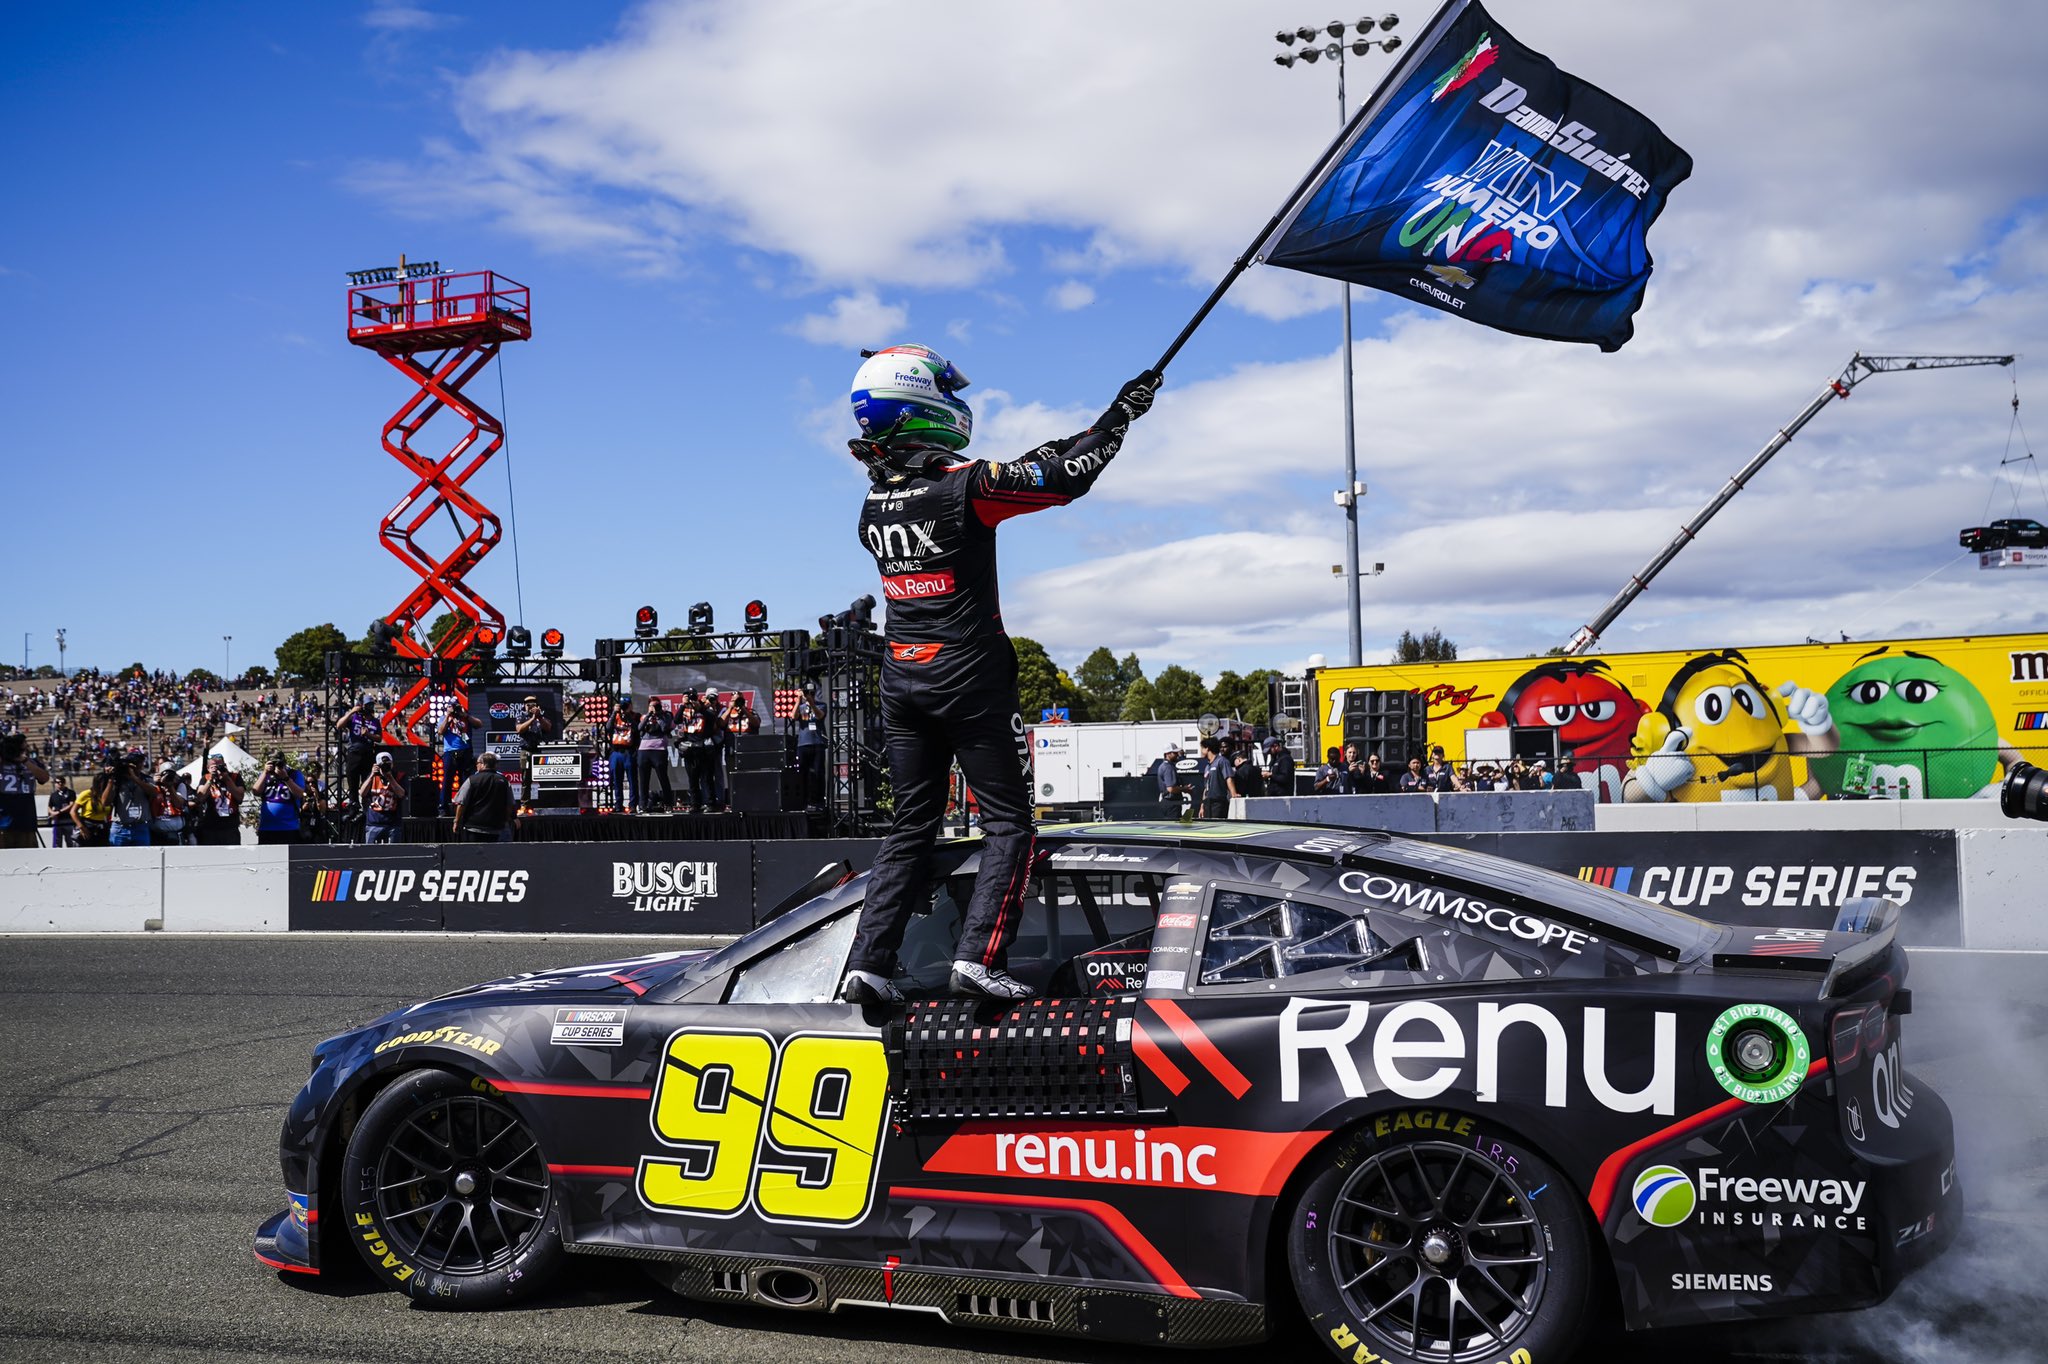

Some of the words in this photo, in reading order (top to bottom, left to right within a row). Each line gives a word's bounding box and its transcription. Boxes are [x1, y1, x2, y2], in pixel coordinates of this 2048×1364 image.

[1549, 121, 1650, 201] Suárez
[1461, 139, 1582, 222] WIN
[1409, 277, 1466, 310] CHEVROLET
[895, 372, 932, 387] Freeway
[895, 382, 932, 391] INSURANCE
[867, 520, 943, 558] onx
[885, 560, 923, 574] HOMES
[905, 578, 946, 599] Renu
[1010, 712, 1034, 776] onx
[547, 756, 574, 764] NASCAR
[354, 870, 416, 901] CUP
[419, 870, 529, 902] SERIES
[612, 861, 718, 897] BUSCH
[1639, 866, 1734, 906] CUP
[1742, 866, 1918, 907] SERIES
[1152, 946, 1190, 954] COMMSCOPE
[1087, 962, 1125, 976] onx
[561, 1026, 581, 1037] CUP
[581, 1027, 614, 1038] SERIES
[577, 1011, 616, 1022] NASCAR
[1712, 1016, 1730, 1036] GET
[1729, 1005, 1800, 1041] BIOETHANOL
[374, 1026, 501, 1056] GOODYEAR
[1279, 997, 1676, 1116] Renu
[1714, 1065, 1734, 1087] GET
[636, 1026, 891, 1229] 99
[1374, 1109, 1476, 1138] EAGLE
[995, 1129, 1217, 1186] renu.inc
[1698, 1168, 1866, 1215] Freeway
[1700, 1212, 1867, 1230] INSURANCE
[355, 1212, 415, 1281] EAGLE
[1671, 1273, 1773, 1291] SIEMENS
